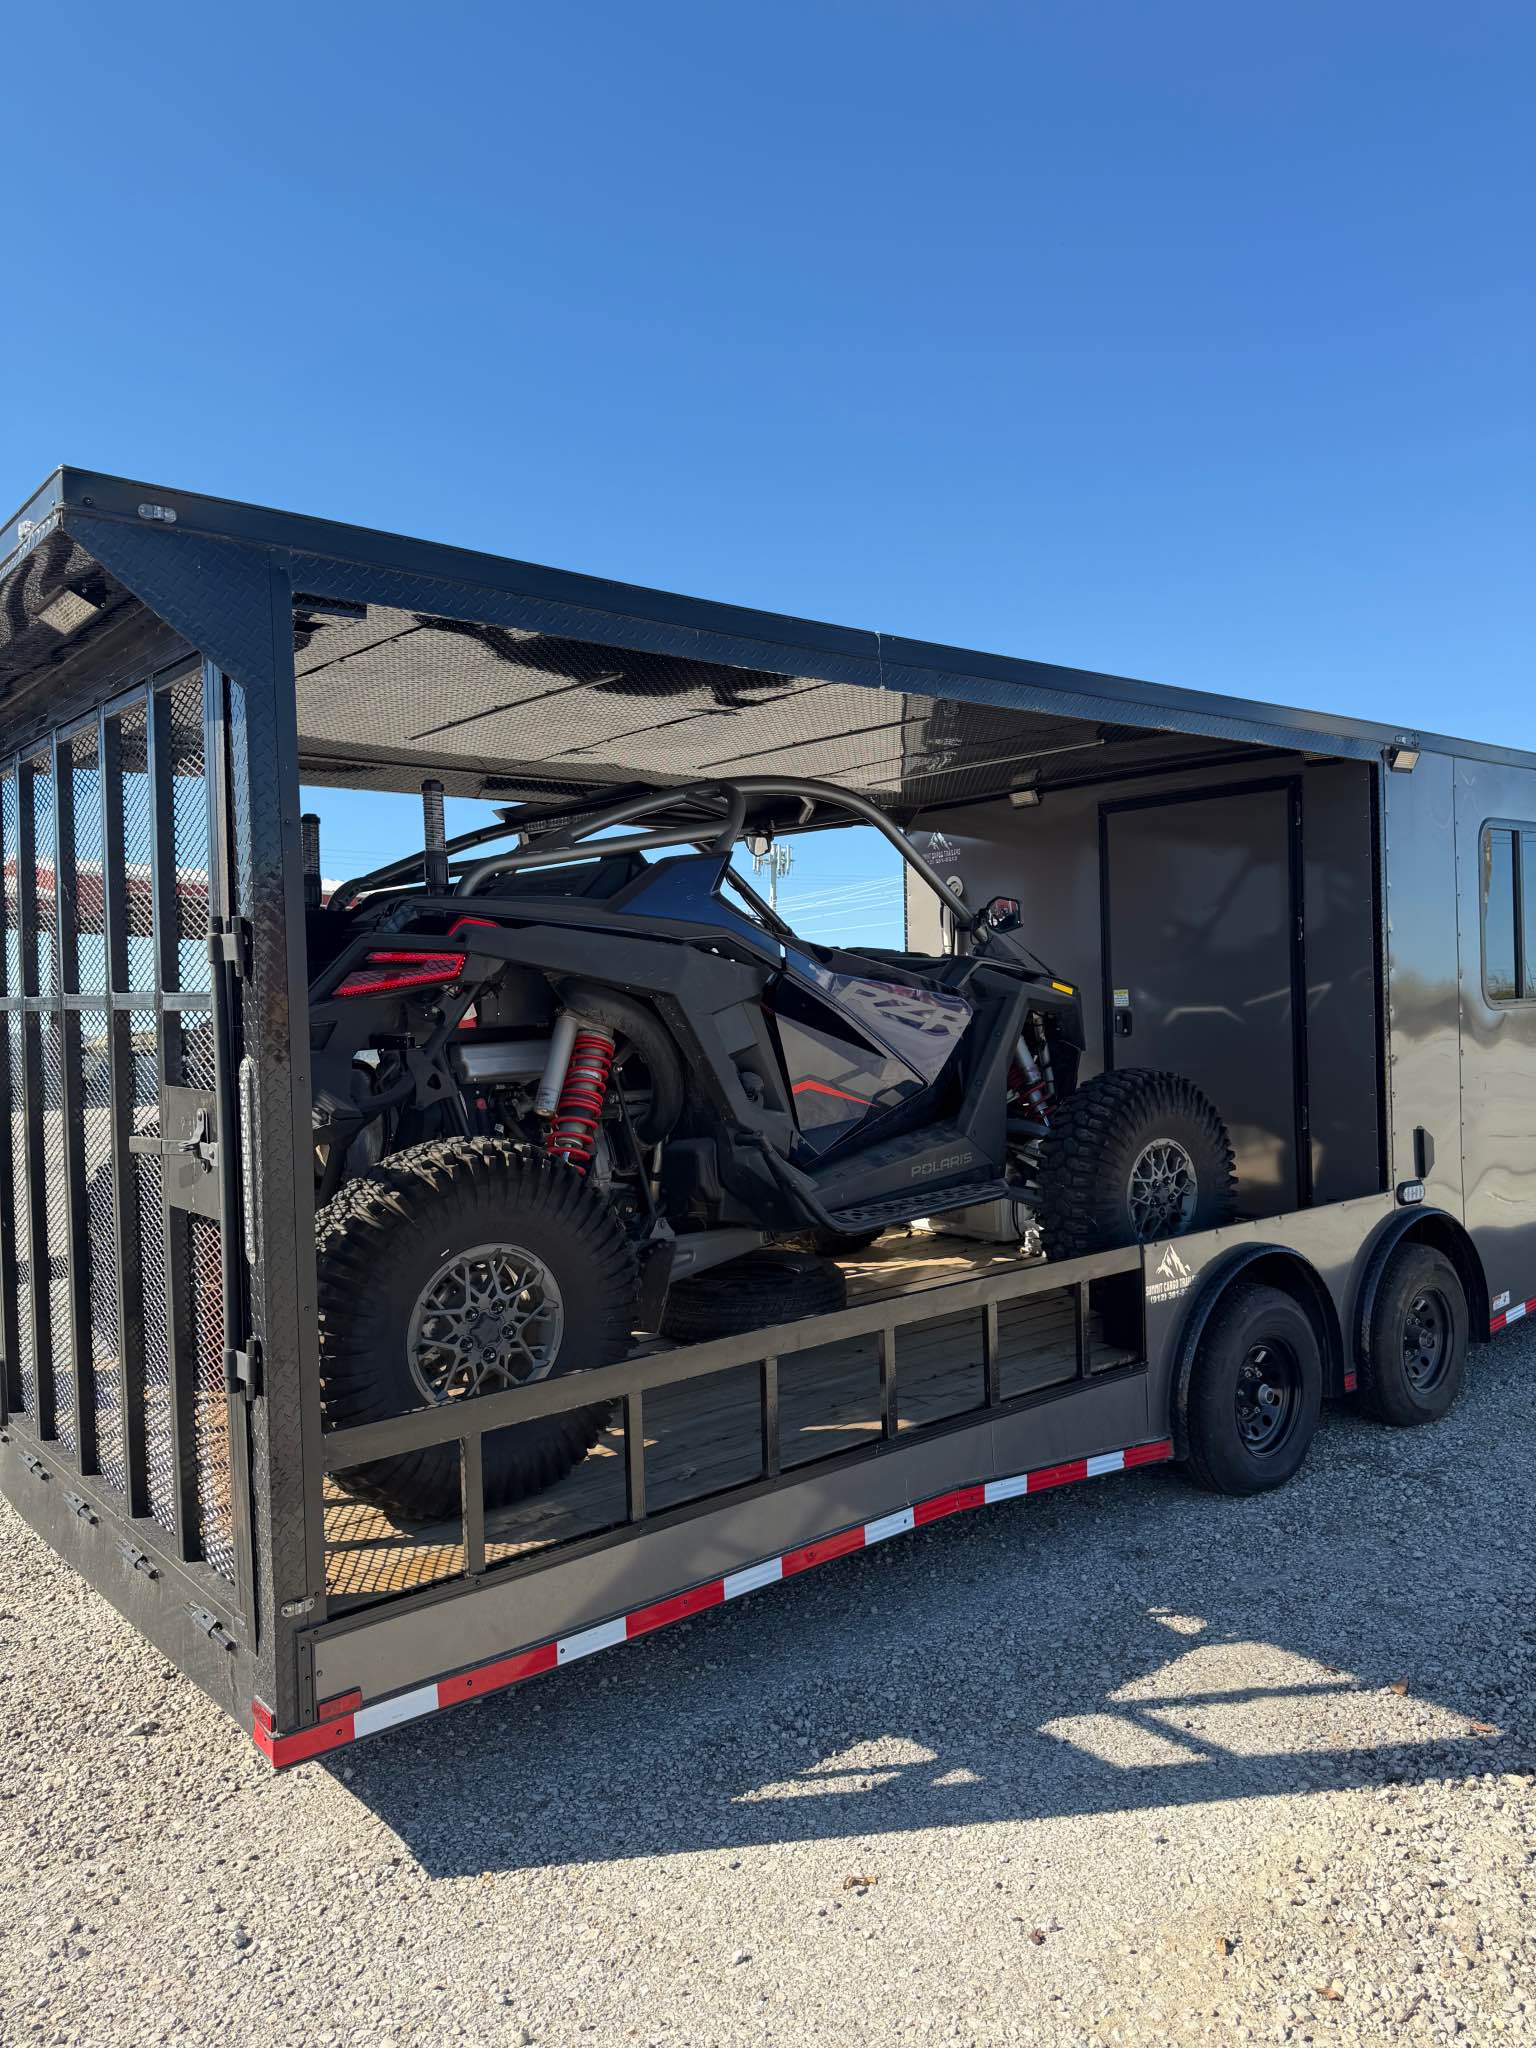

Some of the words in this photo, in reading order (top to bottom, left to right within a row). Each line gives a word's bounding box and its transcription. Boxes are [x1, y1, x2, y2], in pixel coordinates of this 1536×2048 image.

[837, 980, 972, 1039] RZR
[911, 1152, 974, 1178] POLARIS
[1145, 1283, 1163, 1296] SUMMIT
[1163, 1279, 1179, 1292] CARGO
